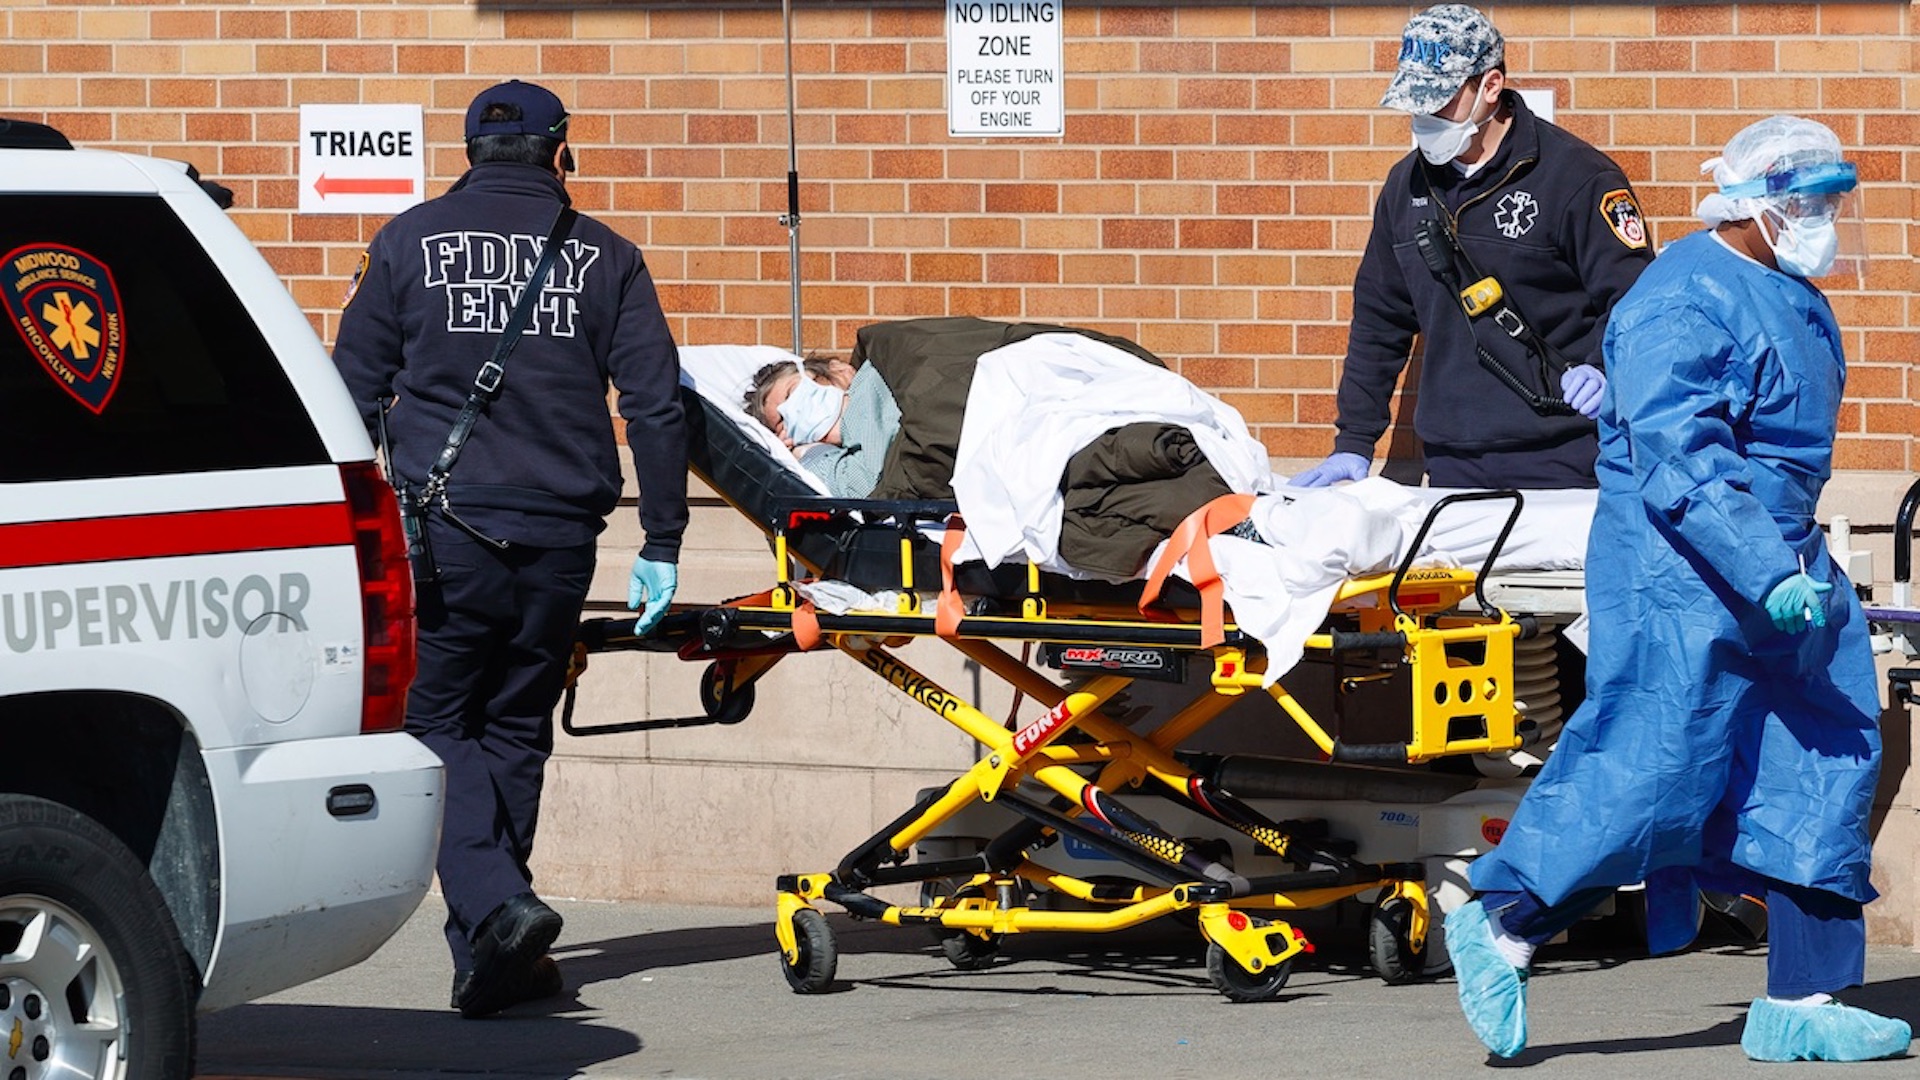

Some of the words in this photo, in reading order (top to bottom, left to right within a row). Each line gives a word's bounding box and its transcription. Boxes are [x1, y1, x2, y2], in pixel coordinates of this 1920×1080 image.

[955, 3, 983, 23] NO
[990, 3, 1054, 23] IDLING
[978, 35, 1031, 56] ZONE
[957, 69, 1011, 84] PLEASE
[1016, 69, 1053, 84] TURN
[970, 90, 997, 105] OFF
[1002, 90, 1041, 105] YOUR
[980, 111, 1032, 127] ENGINE
[310, 131, 413, 157] TRIAGE
[14, 252, 80, 274] MIDWOOD
[421, 231, 600, 293] FDNY
[446, 284, 580, 338] EMT
[106, 312, 120, 348] YORK
[19, 316, 76, 385] BROOKLYN
[101, 348, 118, 381] NEW
[2, 571, 310, 654] UPERVISOR
[1015, 700, 1065, 752] FDNY
